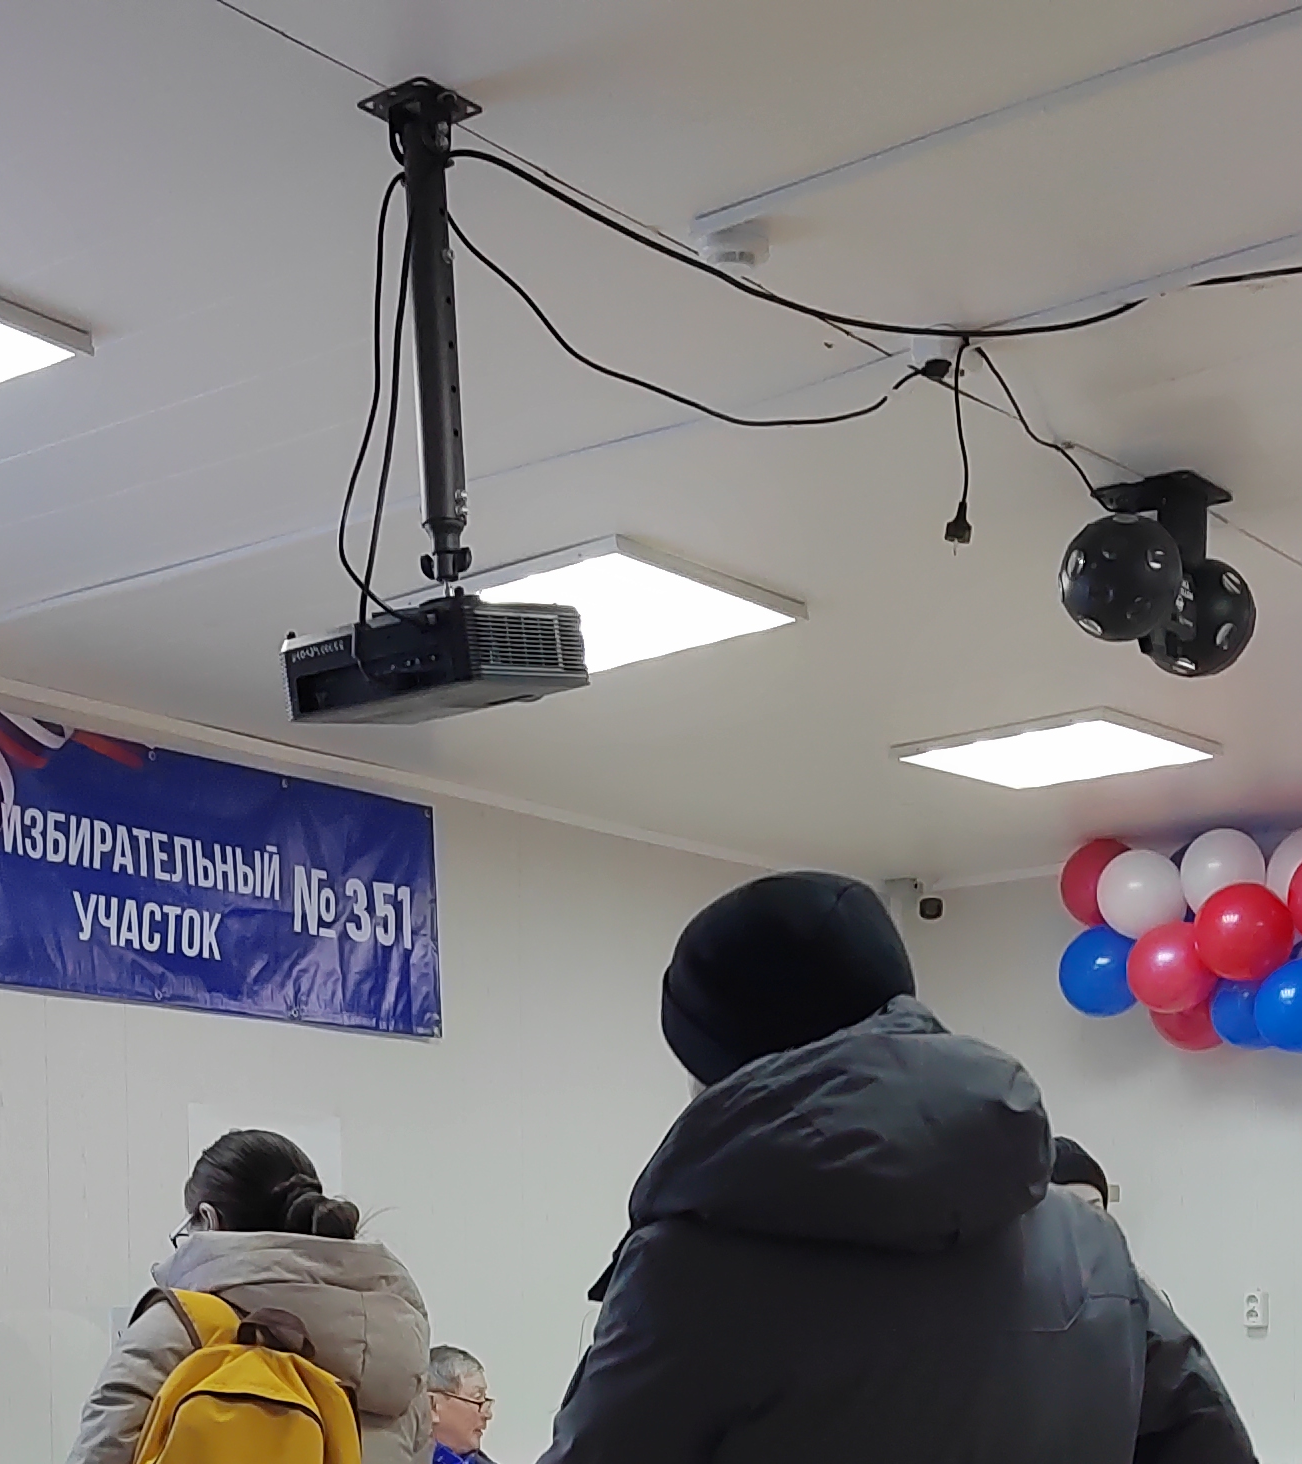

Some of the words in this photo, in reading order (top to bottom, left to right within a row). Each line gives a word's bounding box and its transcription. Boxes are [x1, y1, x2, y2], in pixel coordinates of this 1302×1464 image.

[1, 801, 281, 901] ИЗБИРАТЕЛЬНЫЙ
[72, 890, 222, 961] УЧАСТОК
[293, 864, 337, 938] №
[345, 877, 414, 951] 351
